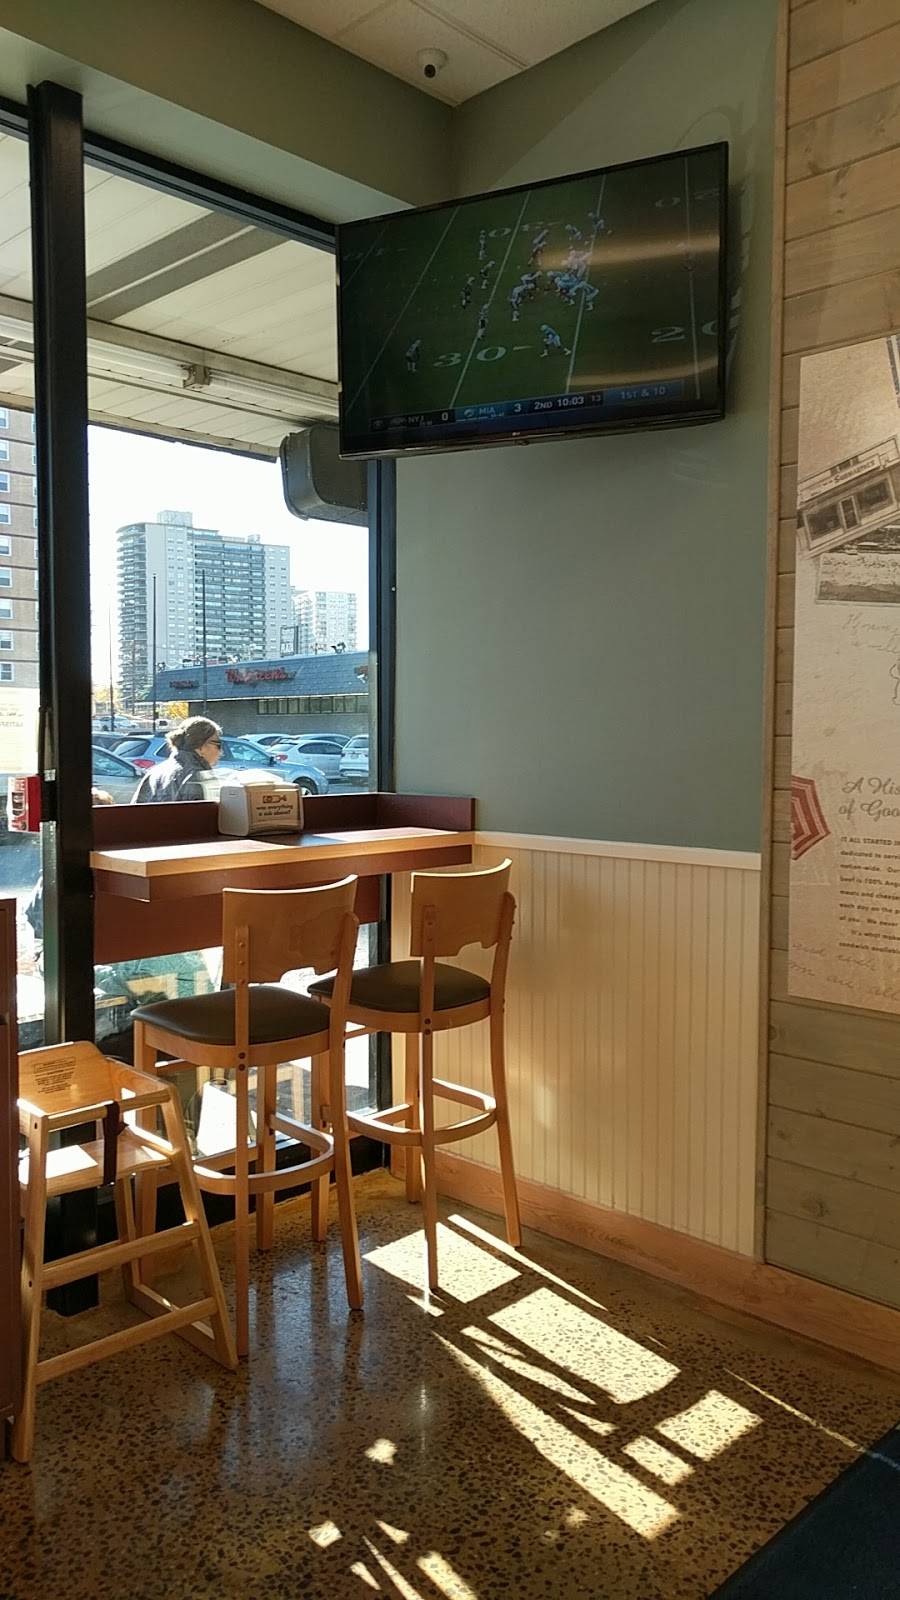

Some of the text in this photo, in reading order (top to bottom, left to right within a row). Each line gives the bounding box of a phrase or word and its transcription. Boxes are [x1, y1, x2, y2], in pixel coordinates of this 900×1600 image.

[441, 411, 449, 421] 0
[479, 406, 495, 415] MIA
[513, 403, 521, 413] 3
[534, 401, 553, 410] 2ND
[557, 396, 585, 407] 10:03
[621, 390, 638, 399] 1ST
[653, 386, 666, 396] 10
[841, 776, 864, 794] A
